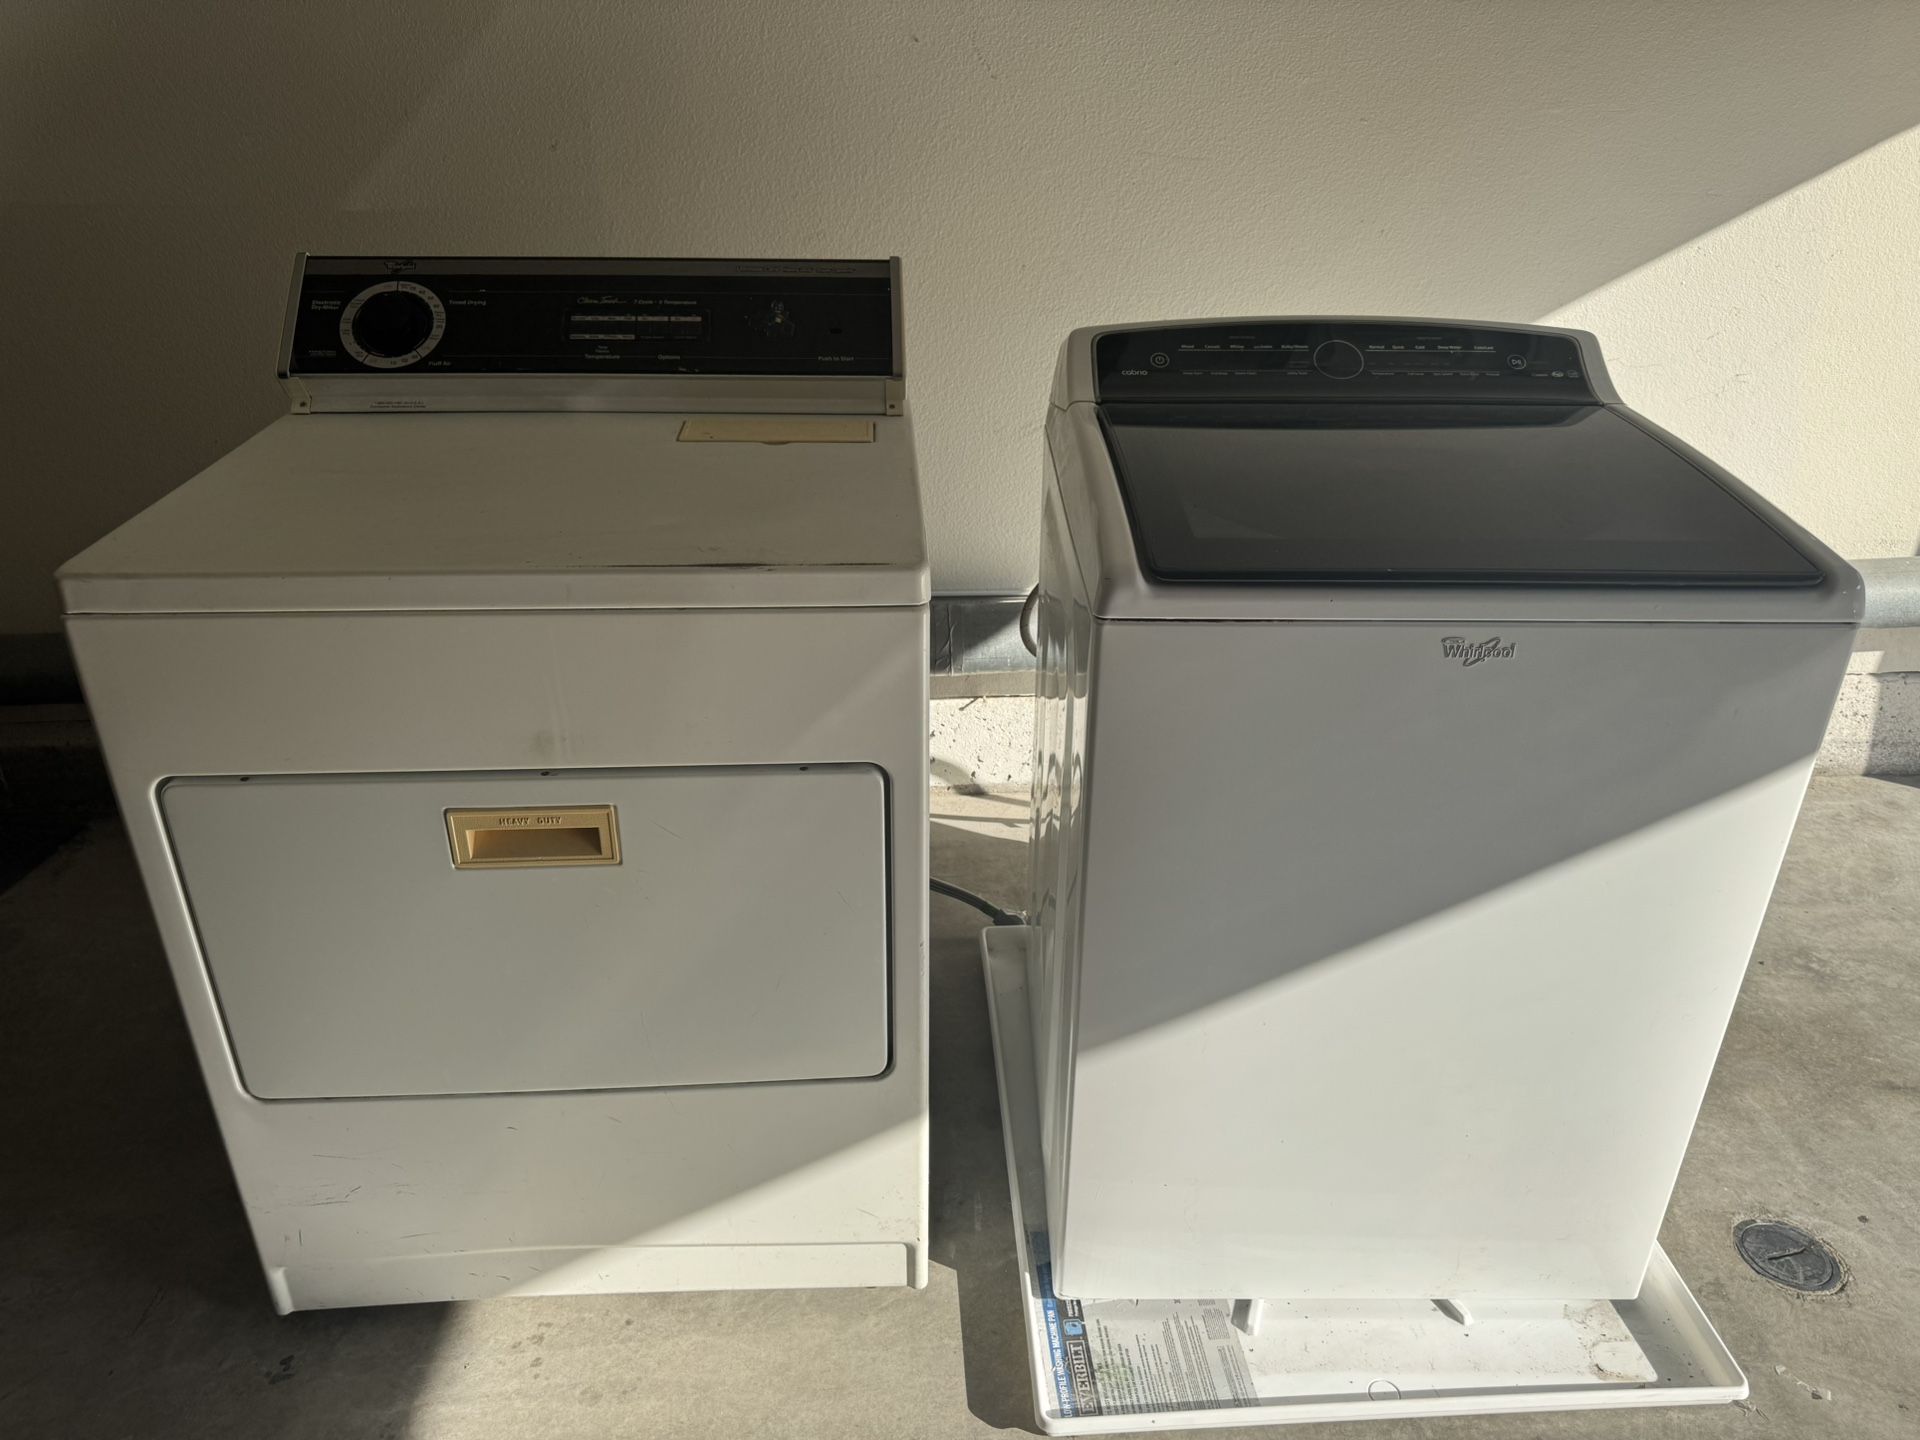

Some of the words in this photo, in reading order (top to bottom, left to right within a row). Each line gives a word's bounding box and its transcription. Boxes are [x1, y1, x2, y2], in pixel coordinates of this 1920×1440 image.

[1441, 637, 1517, 664] Whirlpool
[498, 817, 530, 826] HEAVY
[536, 816, 562, 825] DUTY
[1046, 1309, 1057, 1322] PAN
[1048, 1322, 1061, 1348] MACHINE
[1053, 1349, 1065, 1376] WASHING
[1070, 1344, 1095, 1412] EVERBILT
[1058, 1375, 1073, 1418] LOW-PROFILE
